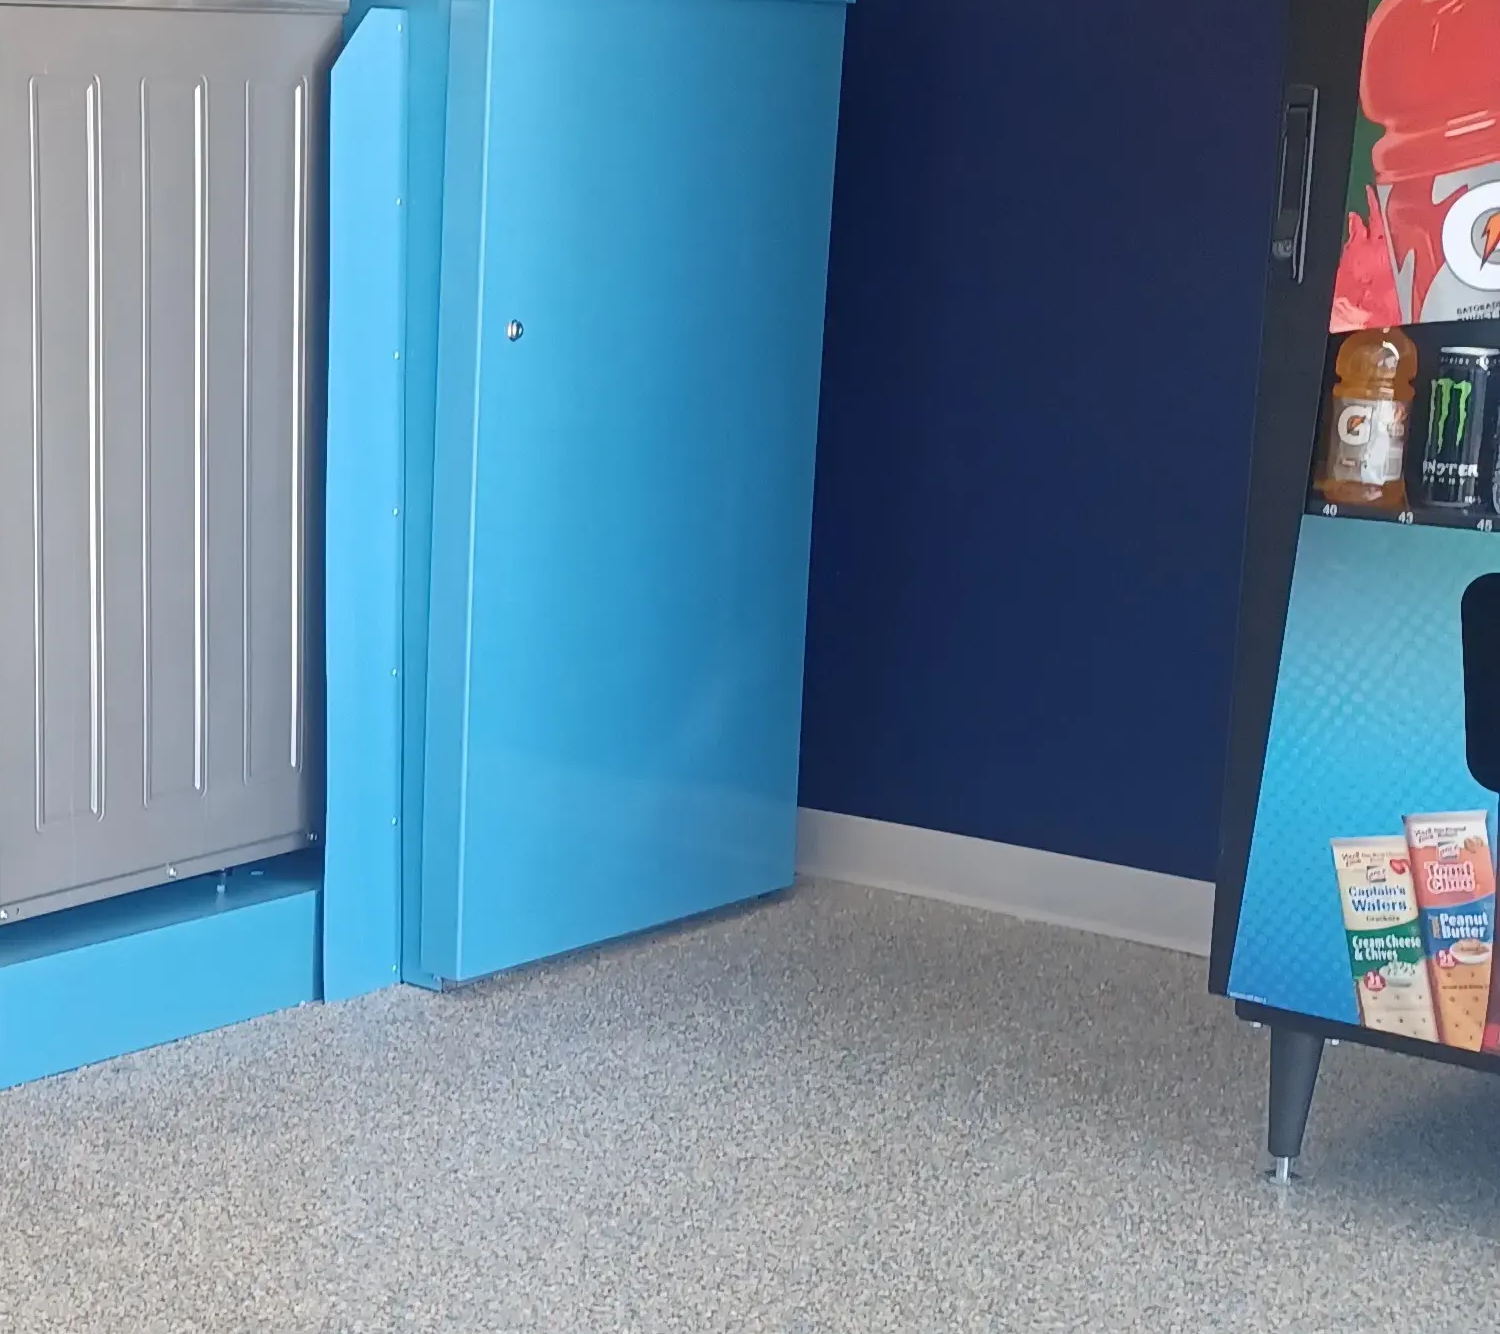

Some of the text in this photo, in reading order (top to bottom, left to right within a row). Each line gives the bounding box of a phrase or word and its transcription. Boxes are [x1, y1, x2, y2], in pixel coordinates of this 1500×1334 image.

[1322, 503, 1338, 517] 40
[1348, 884, 1406, 898] Captain's
[1351, 898, 1407, 912] Wafers
[1439, 911, 1489, 927] Peanut
[1441, 926, 1486, 939] Butter
[1352, 933, 1422, 949] Cream Cheese
[1365, 947, 1399, 962] Chives
